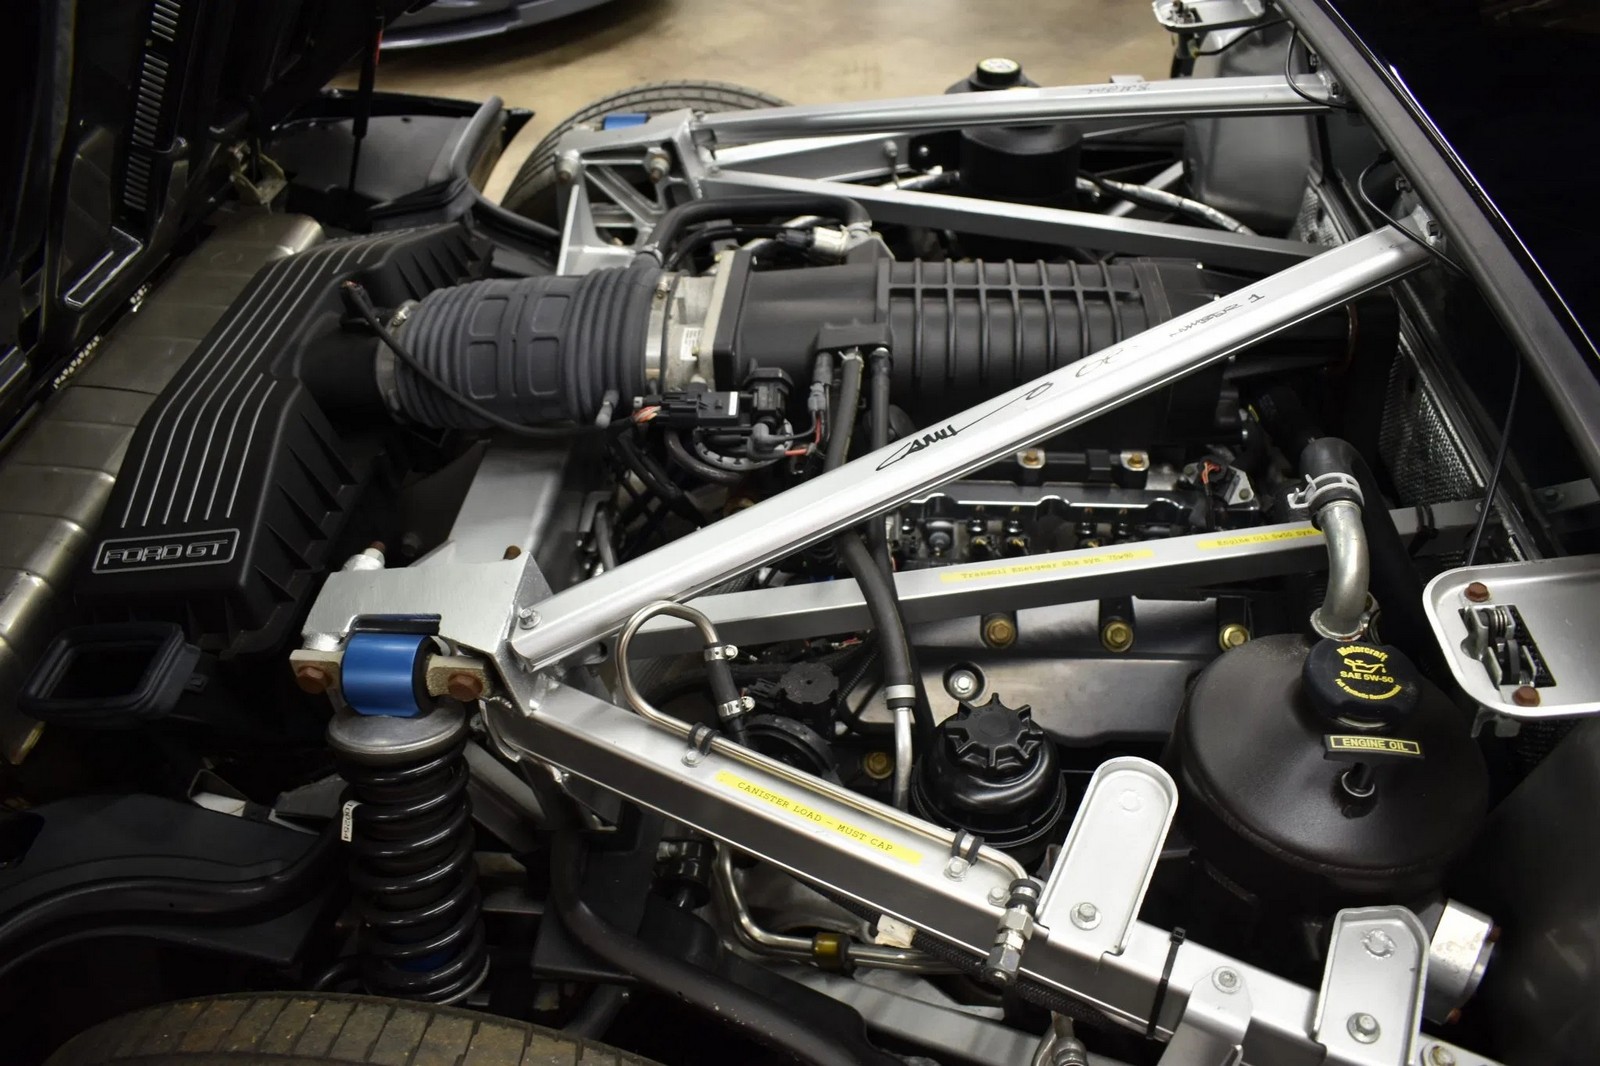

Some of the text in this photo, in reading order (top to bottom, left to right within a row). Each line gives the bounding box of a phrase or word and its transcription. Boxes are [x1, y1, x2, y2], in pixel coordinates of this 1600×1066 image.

[103, 539, 229, 564] FORD GT
[1337, 645, 1388, 661] Motorcraft
[1340, 670, 1394, 683] SAE 5W-50
[1342, 738, 1409, 751] ENGINE OIL
[737, 781, 789, 808] CANISTER
[793, 805, 822, 822] LOAD
[836, 823, 867, 840] MUST
[870, 838, 894, 852] CAP
